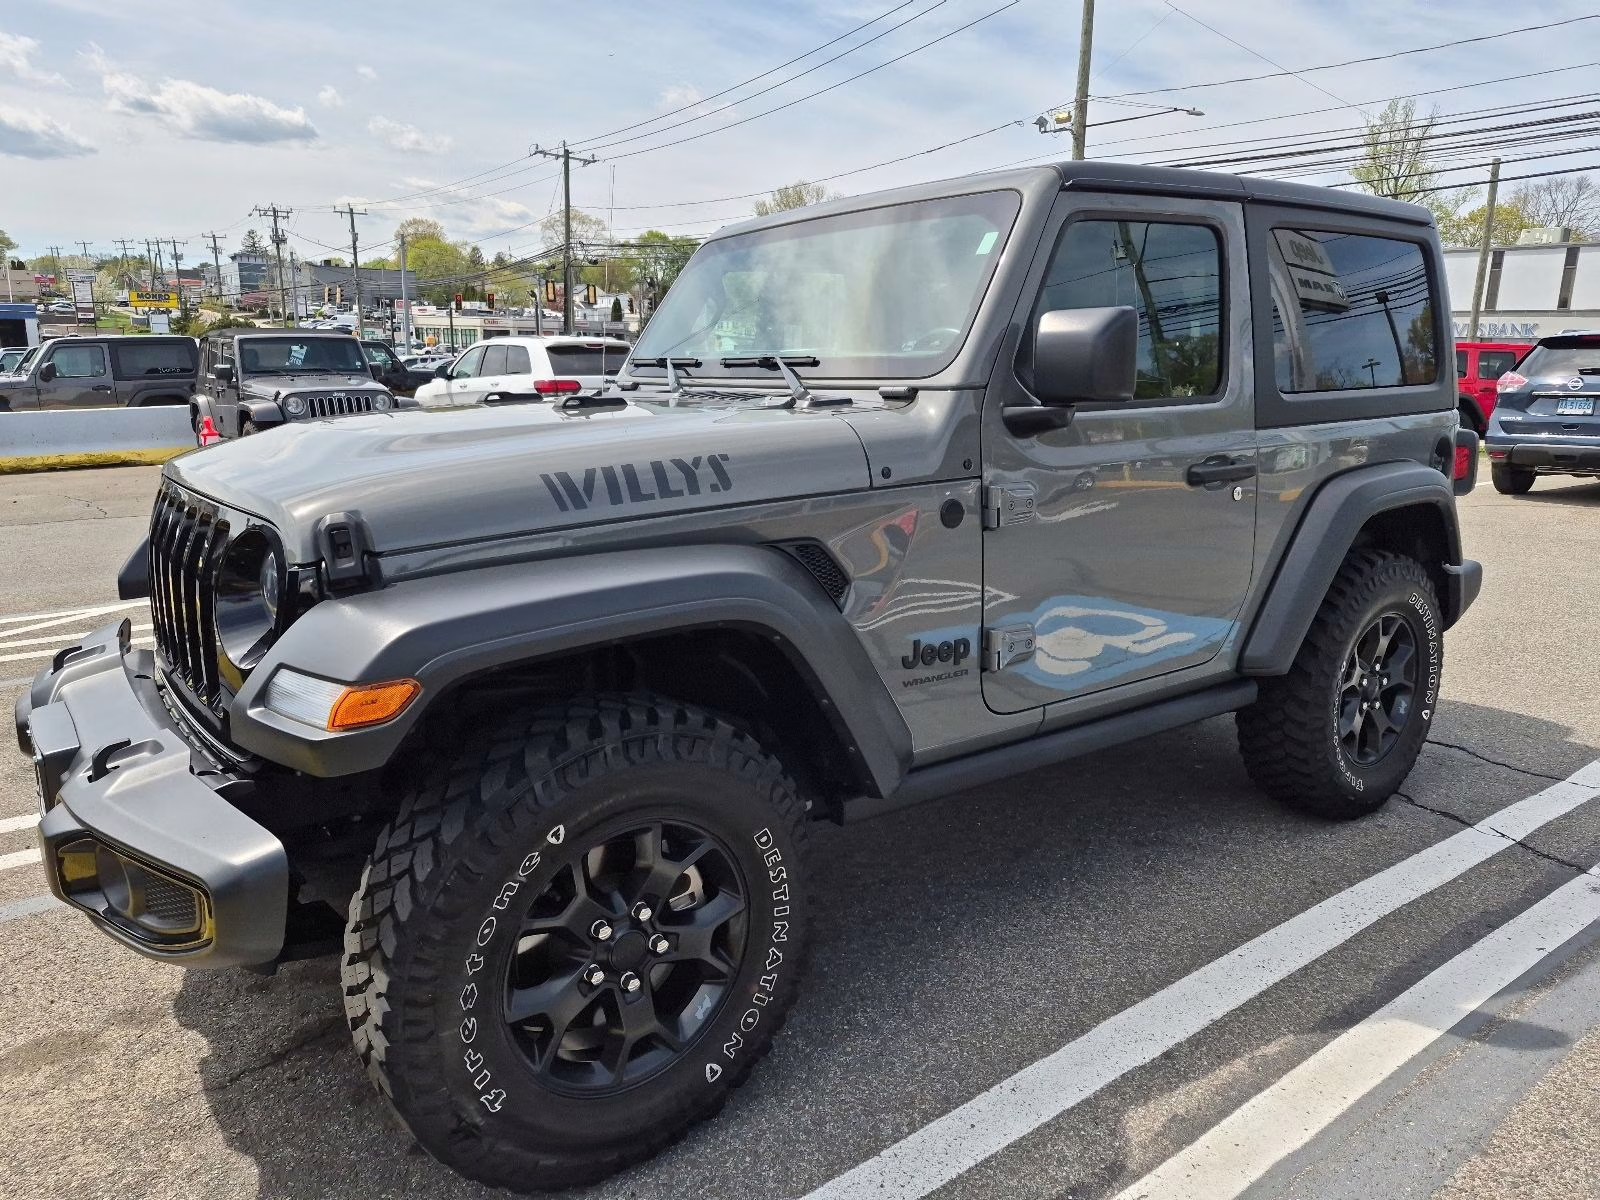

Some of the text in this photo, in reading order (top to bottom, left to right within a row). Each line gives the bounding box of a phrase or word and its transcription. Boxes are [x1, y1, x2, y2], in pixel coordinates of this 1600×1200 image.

[136, 292, 170, 300] MONRO
[539, 453, 732, 512] WILLYS
[901, 637, 971, 670] Jeep
[1408, 592, 1438, 704] DESTINATION
[902, 669, 969, 688] WRANGLER
[723, 827, 790, 1059] DESTINATION
[459, 851, 541, 1112] Firestone
